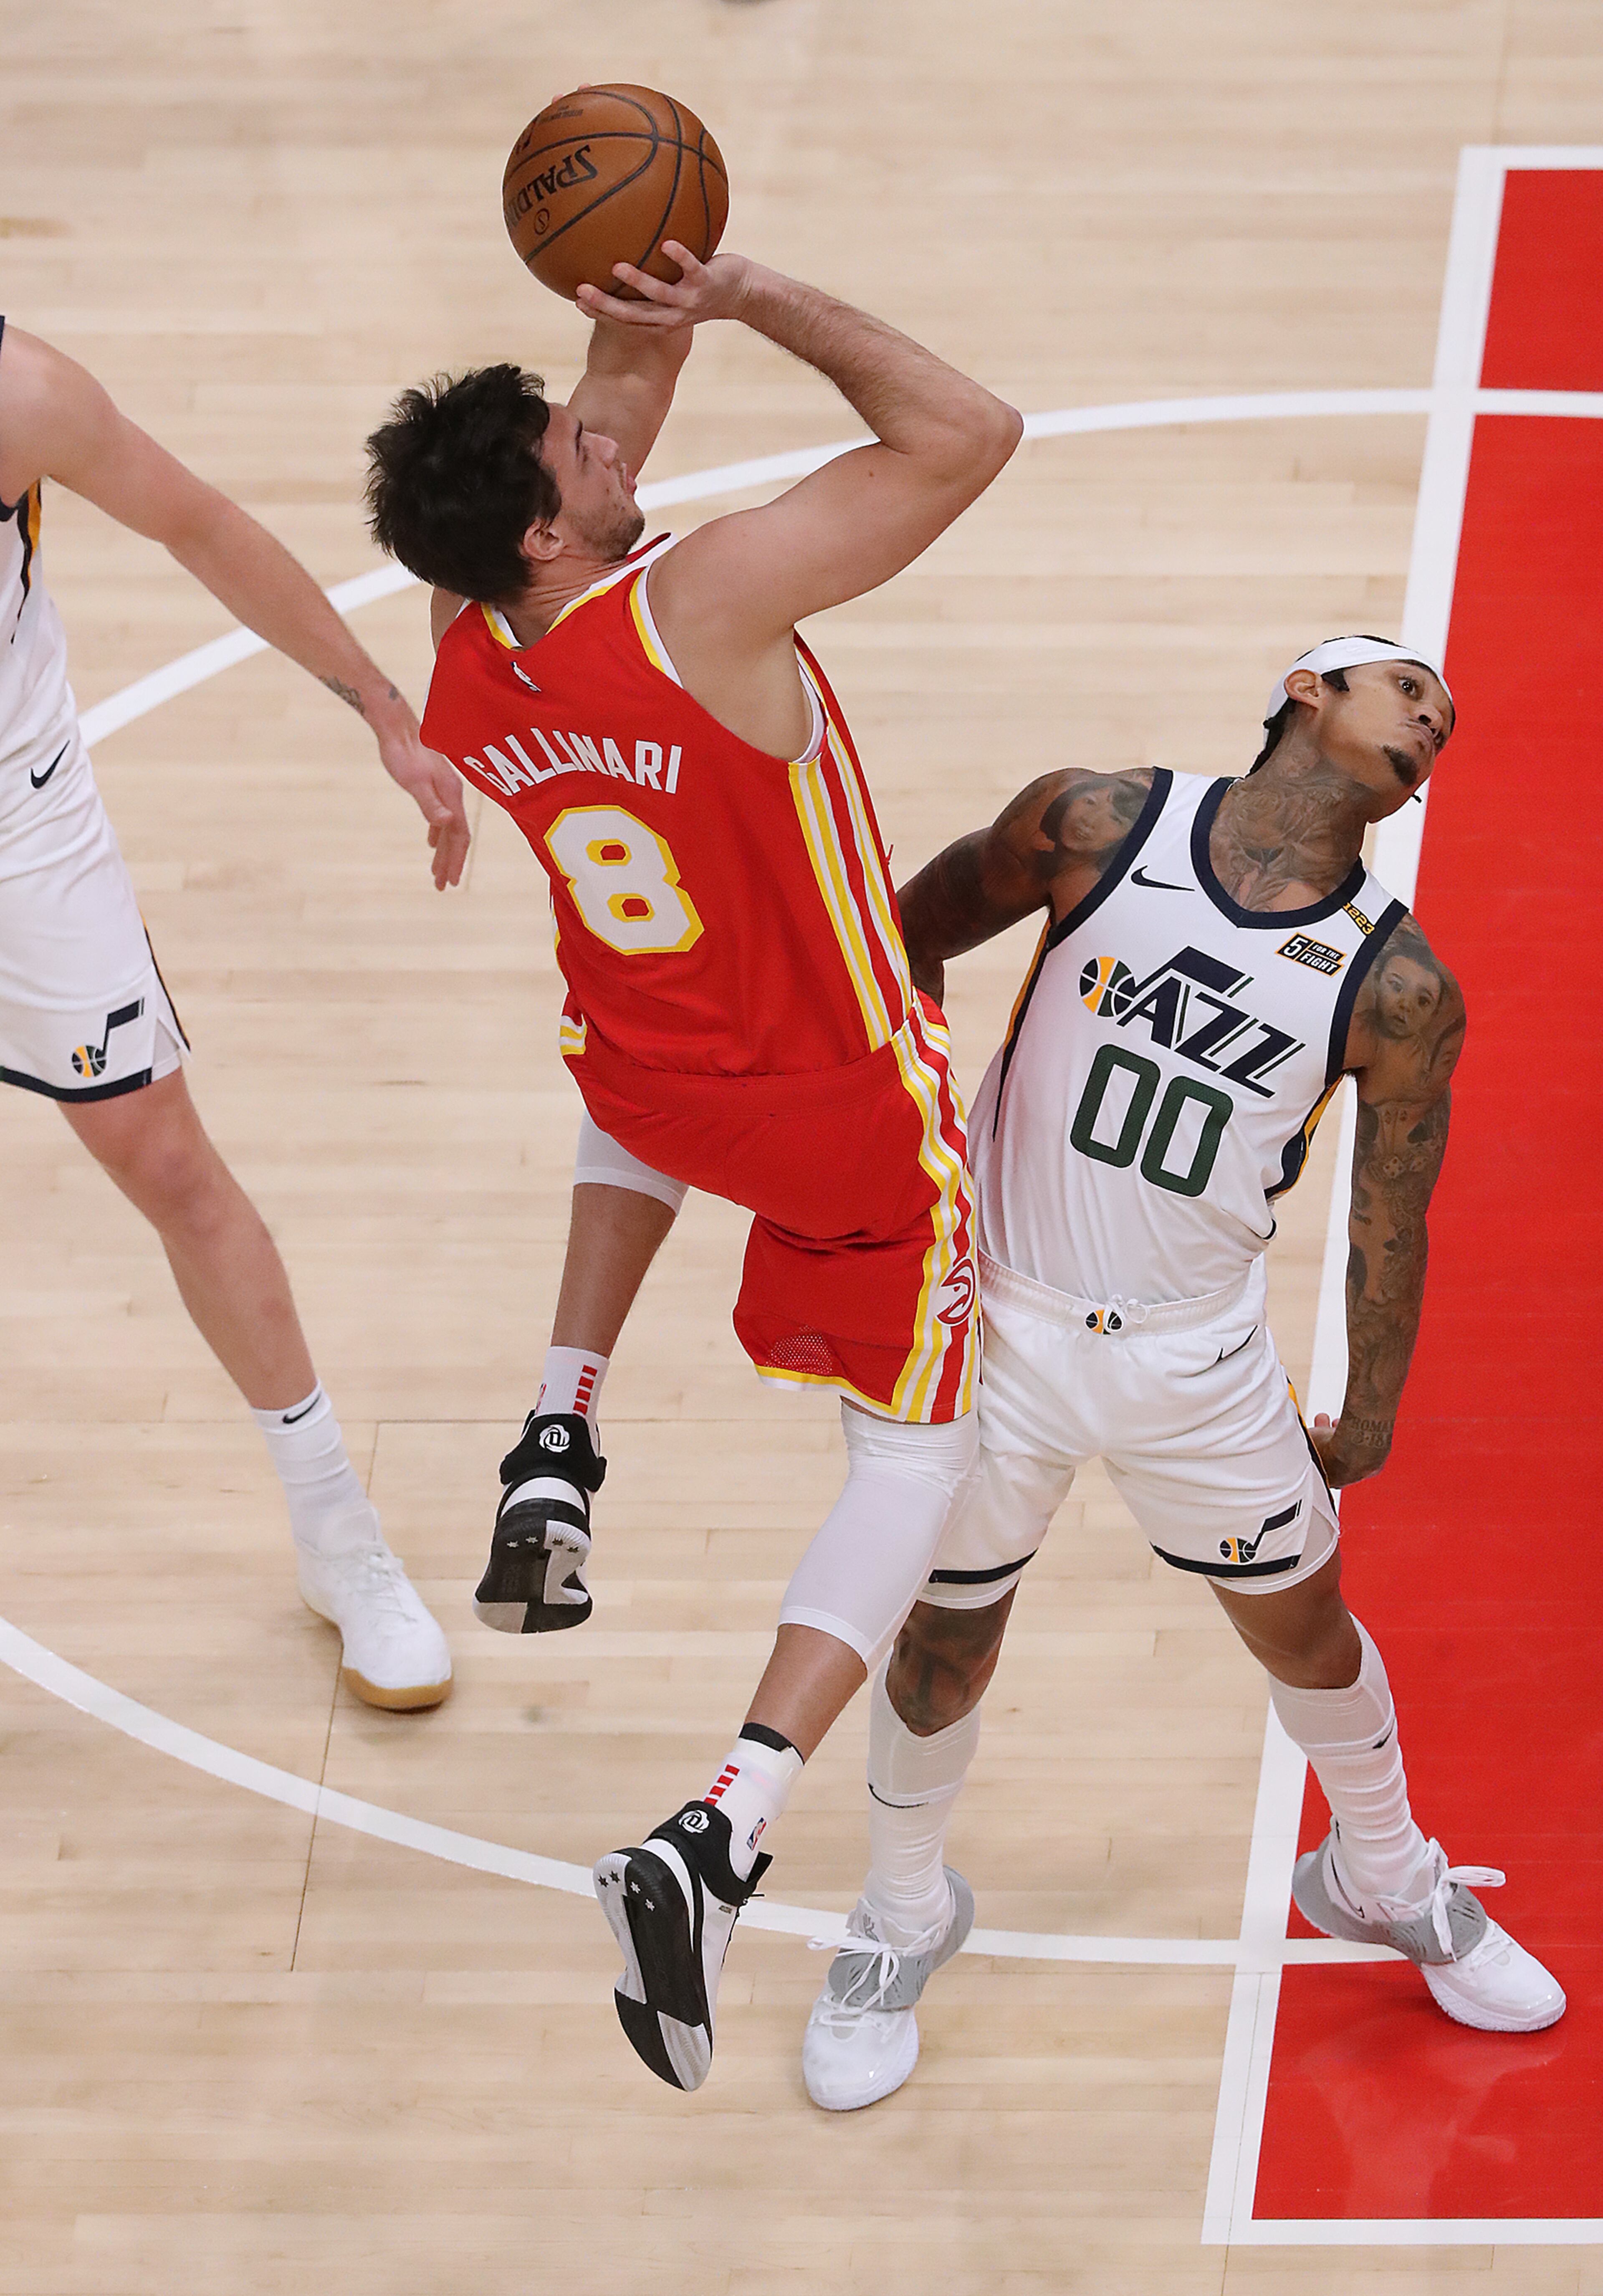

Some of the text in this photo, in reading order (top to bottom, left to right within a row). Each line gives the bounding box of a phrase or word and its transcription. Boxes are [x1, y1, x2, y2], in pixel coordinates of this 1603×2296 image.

[506, 145, 597, 228] SPALDIN
[463, 728, 682, 796] GALLINARI
[544, 804, 705, 956] 8
[1343, 902, 1375, 934] 1223
[1283, 937, 1308, 956] 5
[1300, 953, 1337, 973] FIGHT
[1312, 944, 1340, 959] FOR THE
[1070, 1043, 1234, 1197] 00
